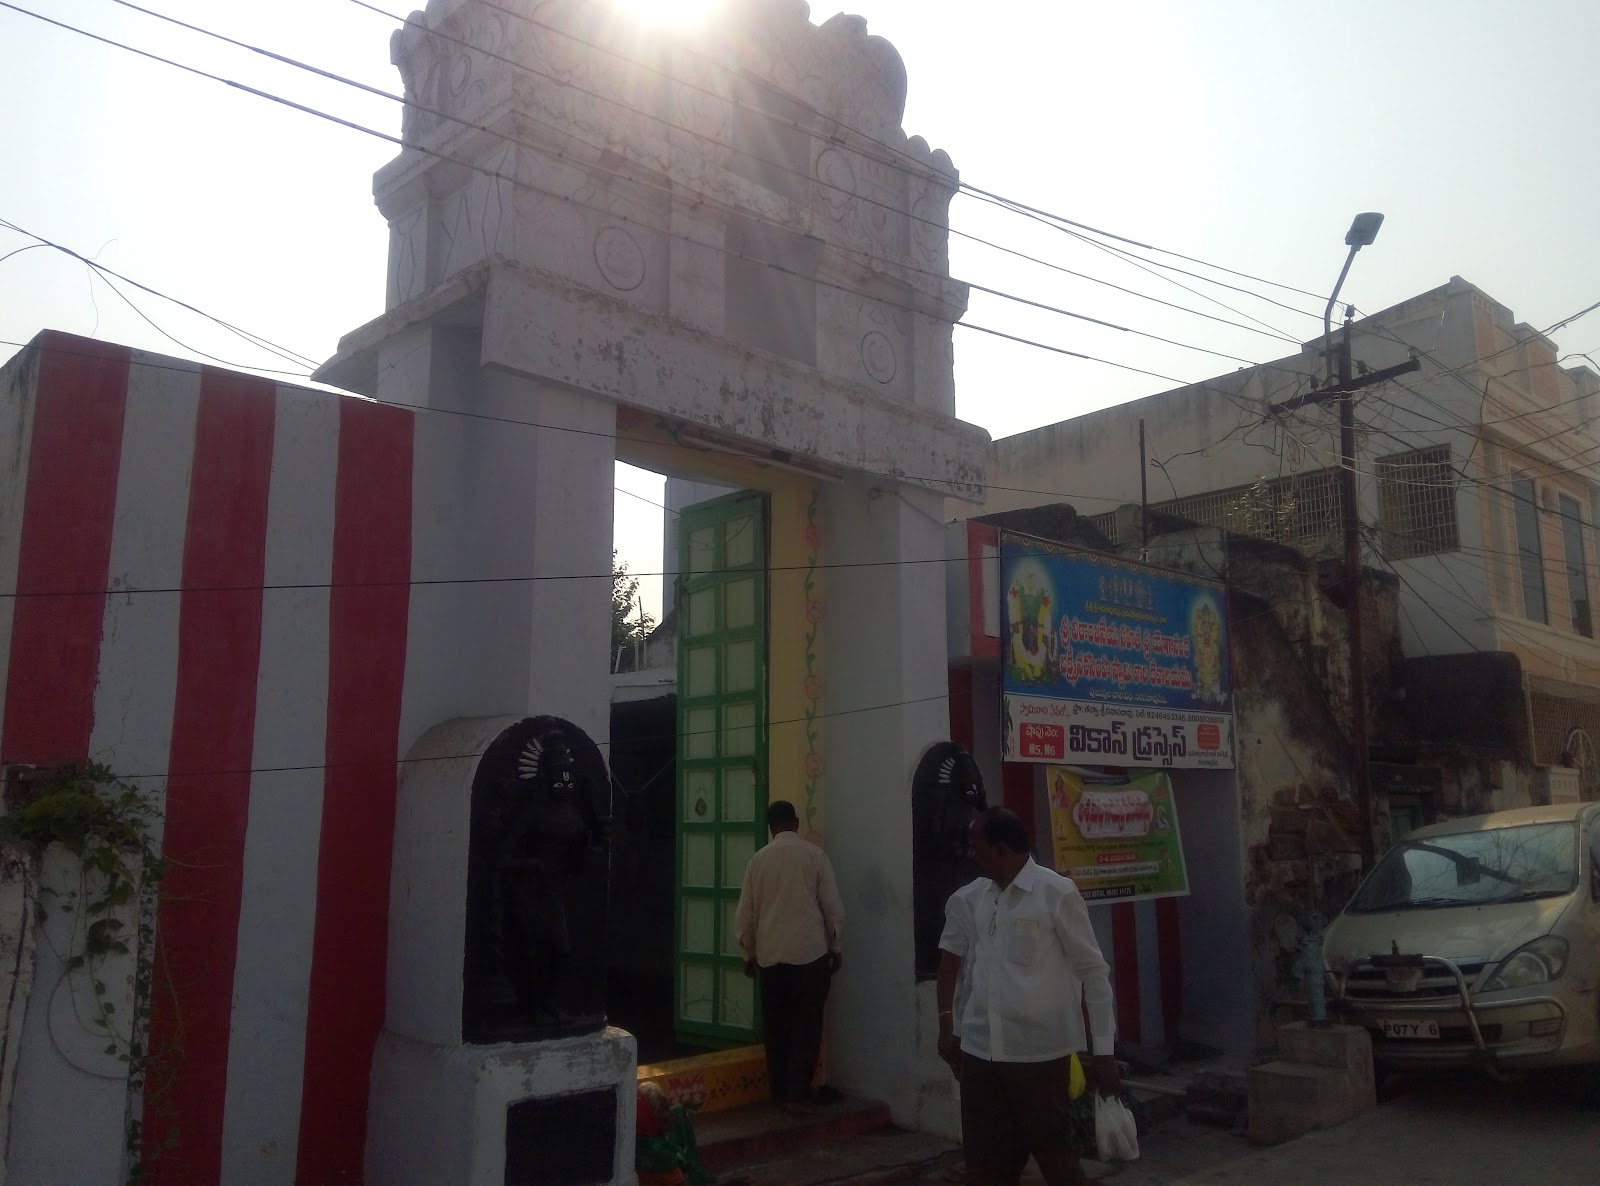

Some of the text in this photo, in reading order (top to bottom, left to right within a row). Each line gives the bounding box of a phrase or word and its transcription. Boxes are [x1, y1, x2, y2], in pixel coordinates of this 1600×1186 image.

[1060, 615, 1070, 648] శ్రీ
[1143, 629, 1151, 659] శ్రీ
[1069, 721, 1127, 755] వికాస్
